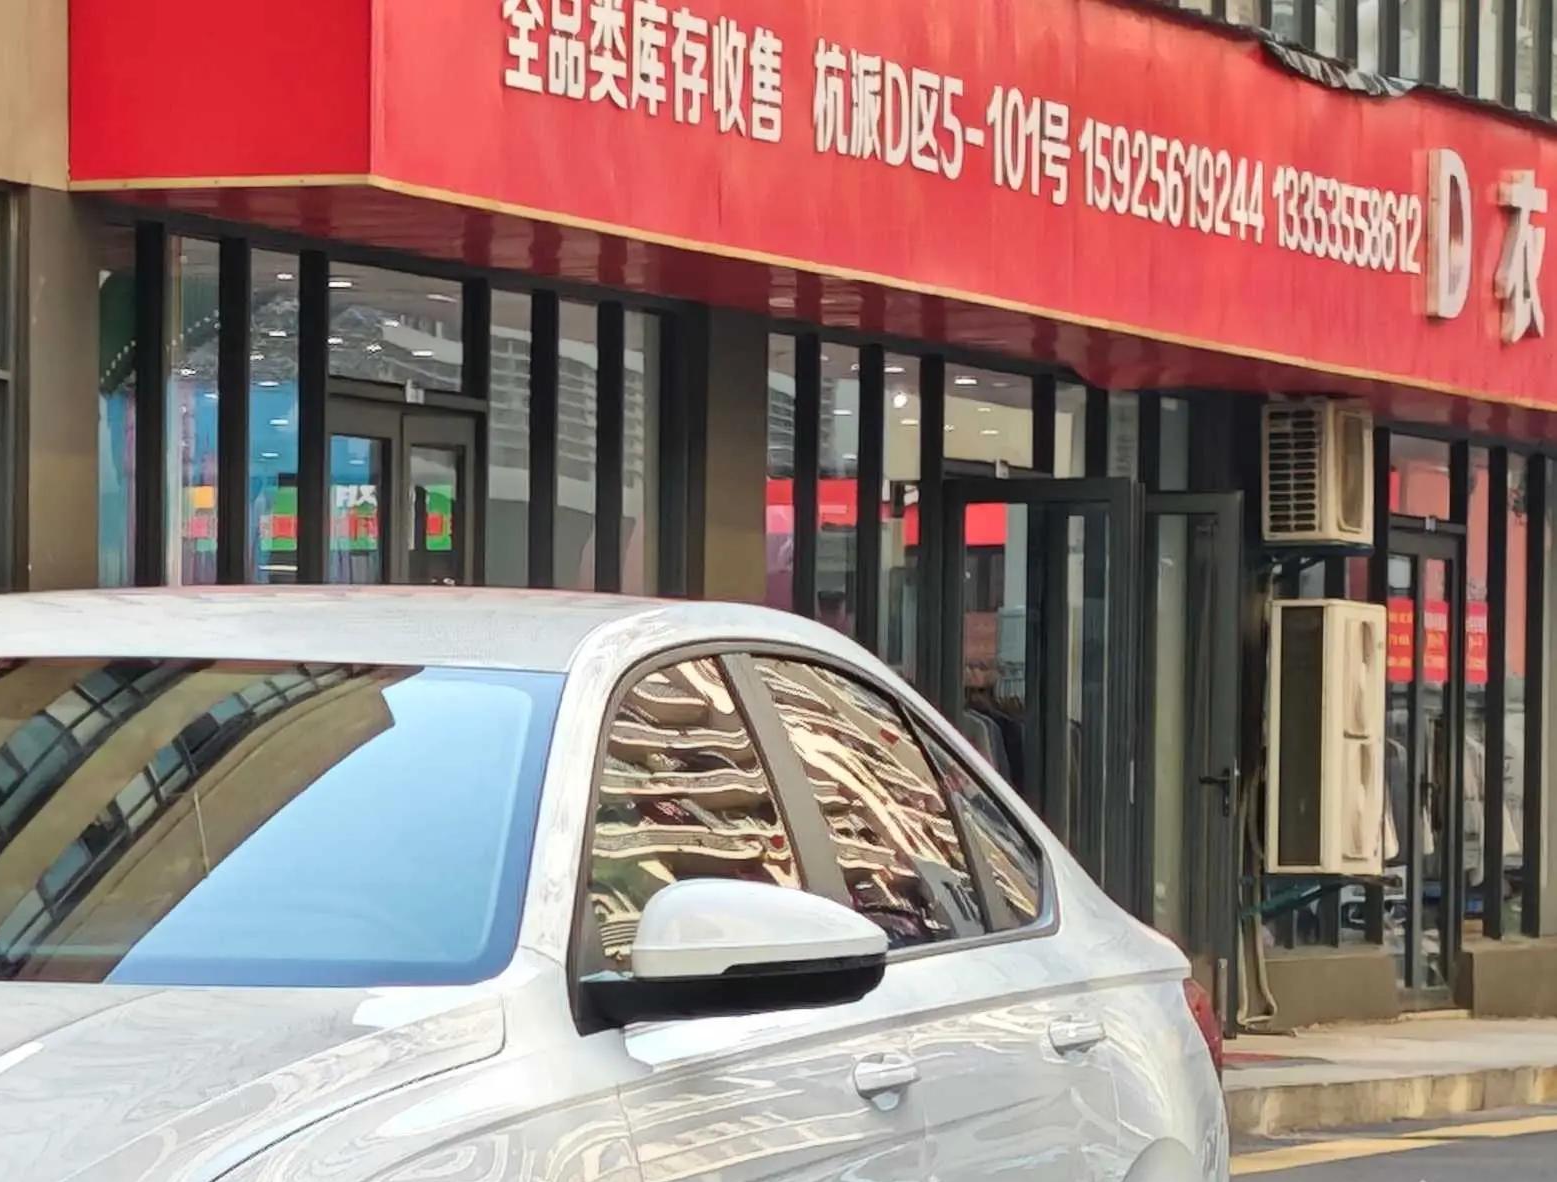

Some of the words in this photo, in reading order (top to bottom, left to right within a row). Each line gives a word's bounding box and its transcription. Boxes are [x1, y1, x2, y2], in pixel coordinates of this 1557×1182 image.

[502, 0, 782, 143] 全品类库存收售
[1078, 117, 1265, 245] 15925619244
[1273, 165, 1422, 274] 13353558612
